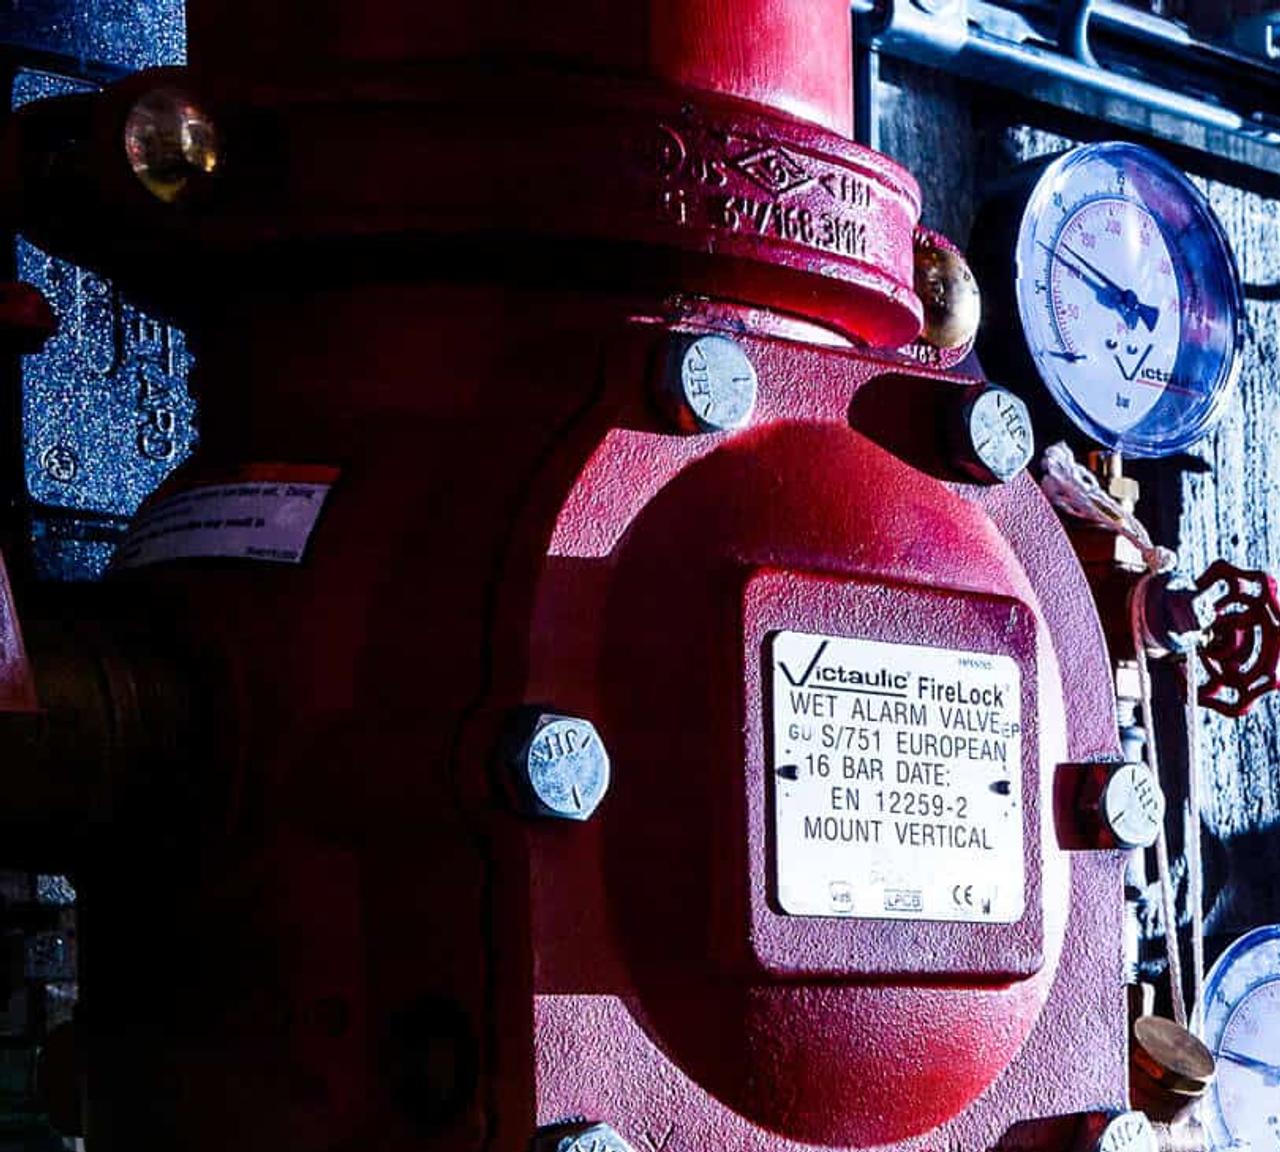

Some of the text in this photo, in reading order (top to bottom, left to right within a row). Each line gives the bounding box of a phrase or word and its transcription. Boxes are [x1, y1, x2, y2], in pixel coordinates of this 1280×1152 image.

[778, 640, 1004, 709] Victaulic FireLock
[790, 690, 1000, 734] WET ALARM VALVE
[821, 725, 881, 751] S/751
[897, 731, 1007, 762] EUROPEAN
[805, 754, 951, 788] 16 BAR DATE:
[831, 787, 969, 820] EN 12259-2
[804, 816, 996, 851] MOUNT VERTICAL
